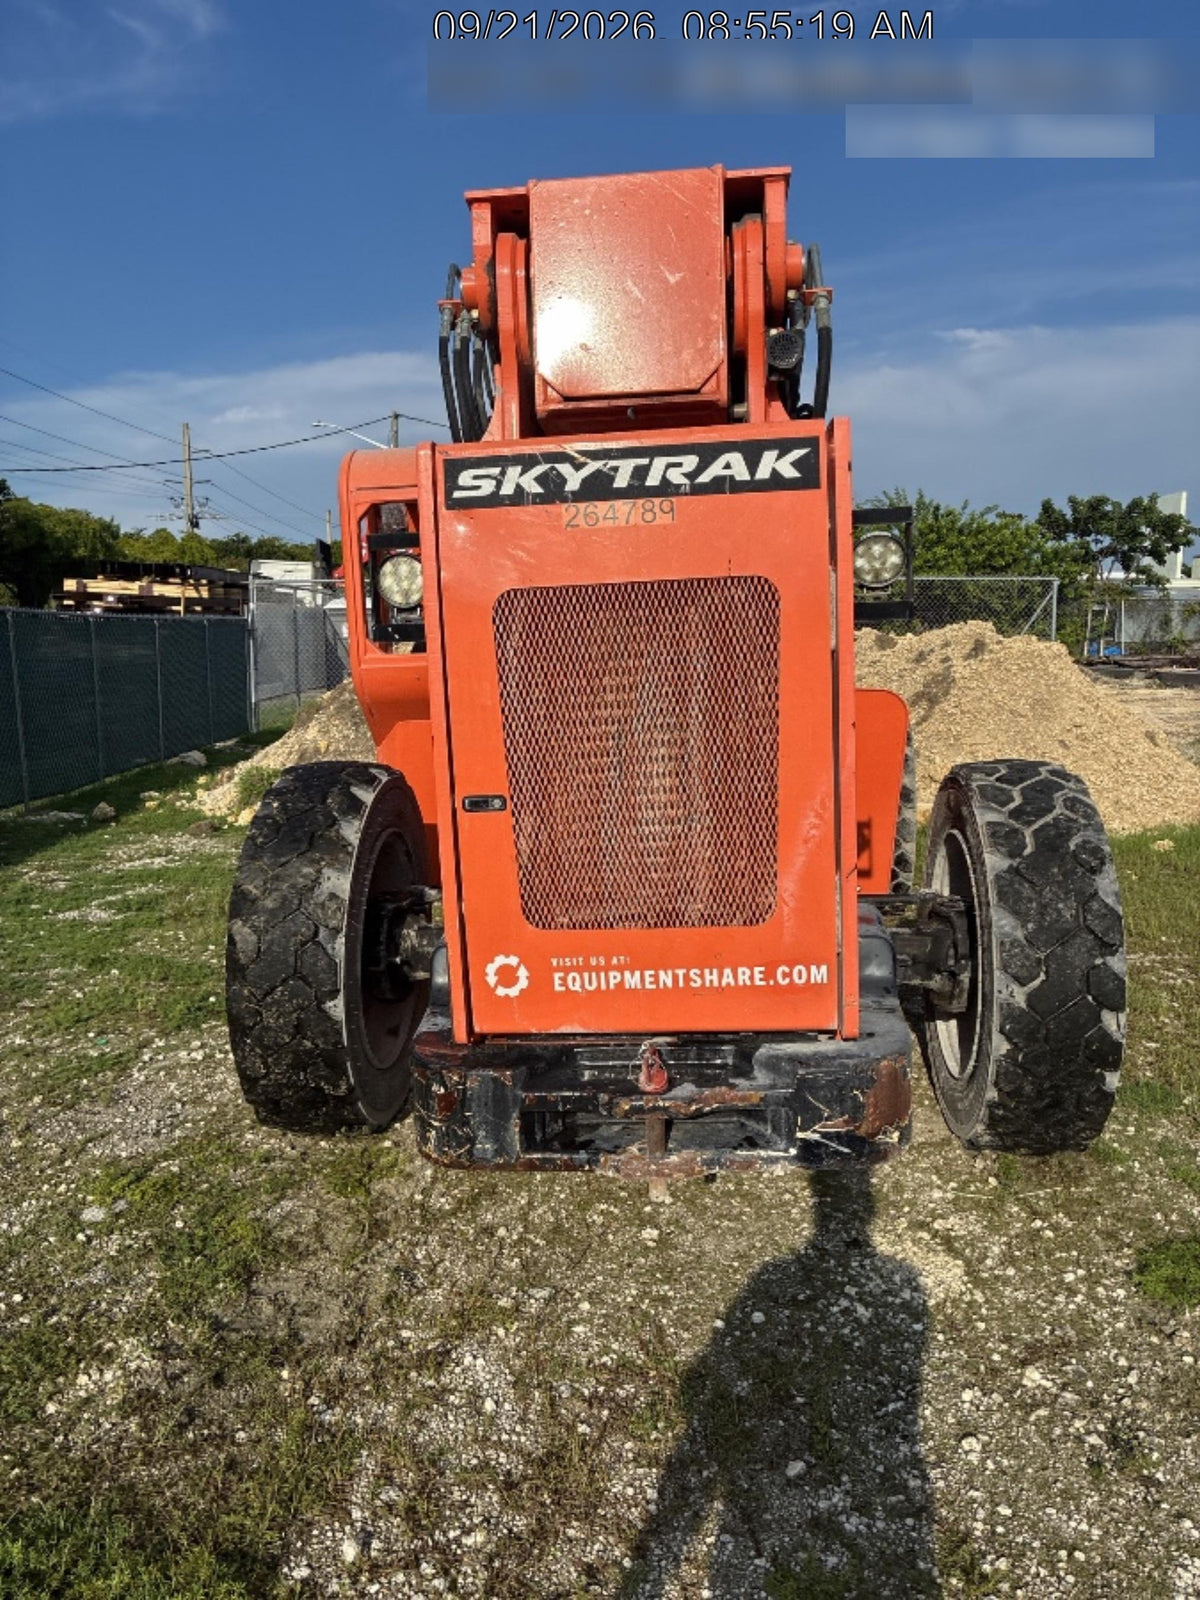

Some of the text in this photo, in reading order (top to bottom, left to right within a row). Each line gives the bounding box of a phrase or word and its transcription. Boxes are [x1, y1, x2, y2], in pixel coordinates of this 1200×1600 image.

[452, 448, 811, 498] SKYTRAK
[564, 499, 676, 530] 264789
[550, 957, 584, 967] VISIT
[590, 956, 605, 966] US
[553, 965, 828, 992] EQUIPMENTSHARE.COM
